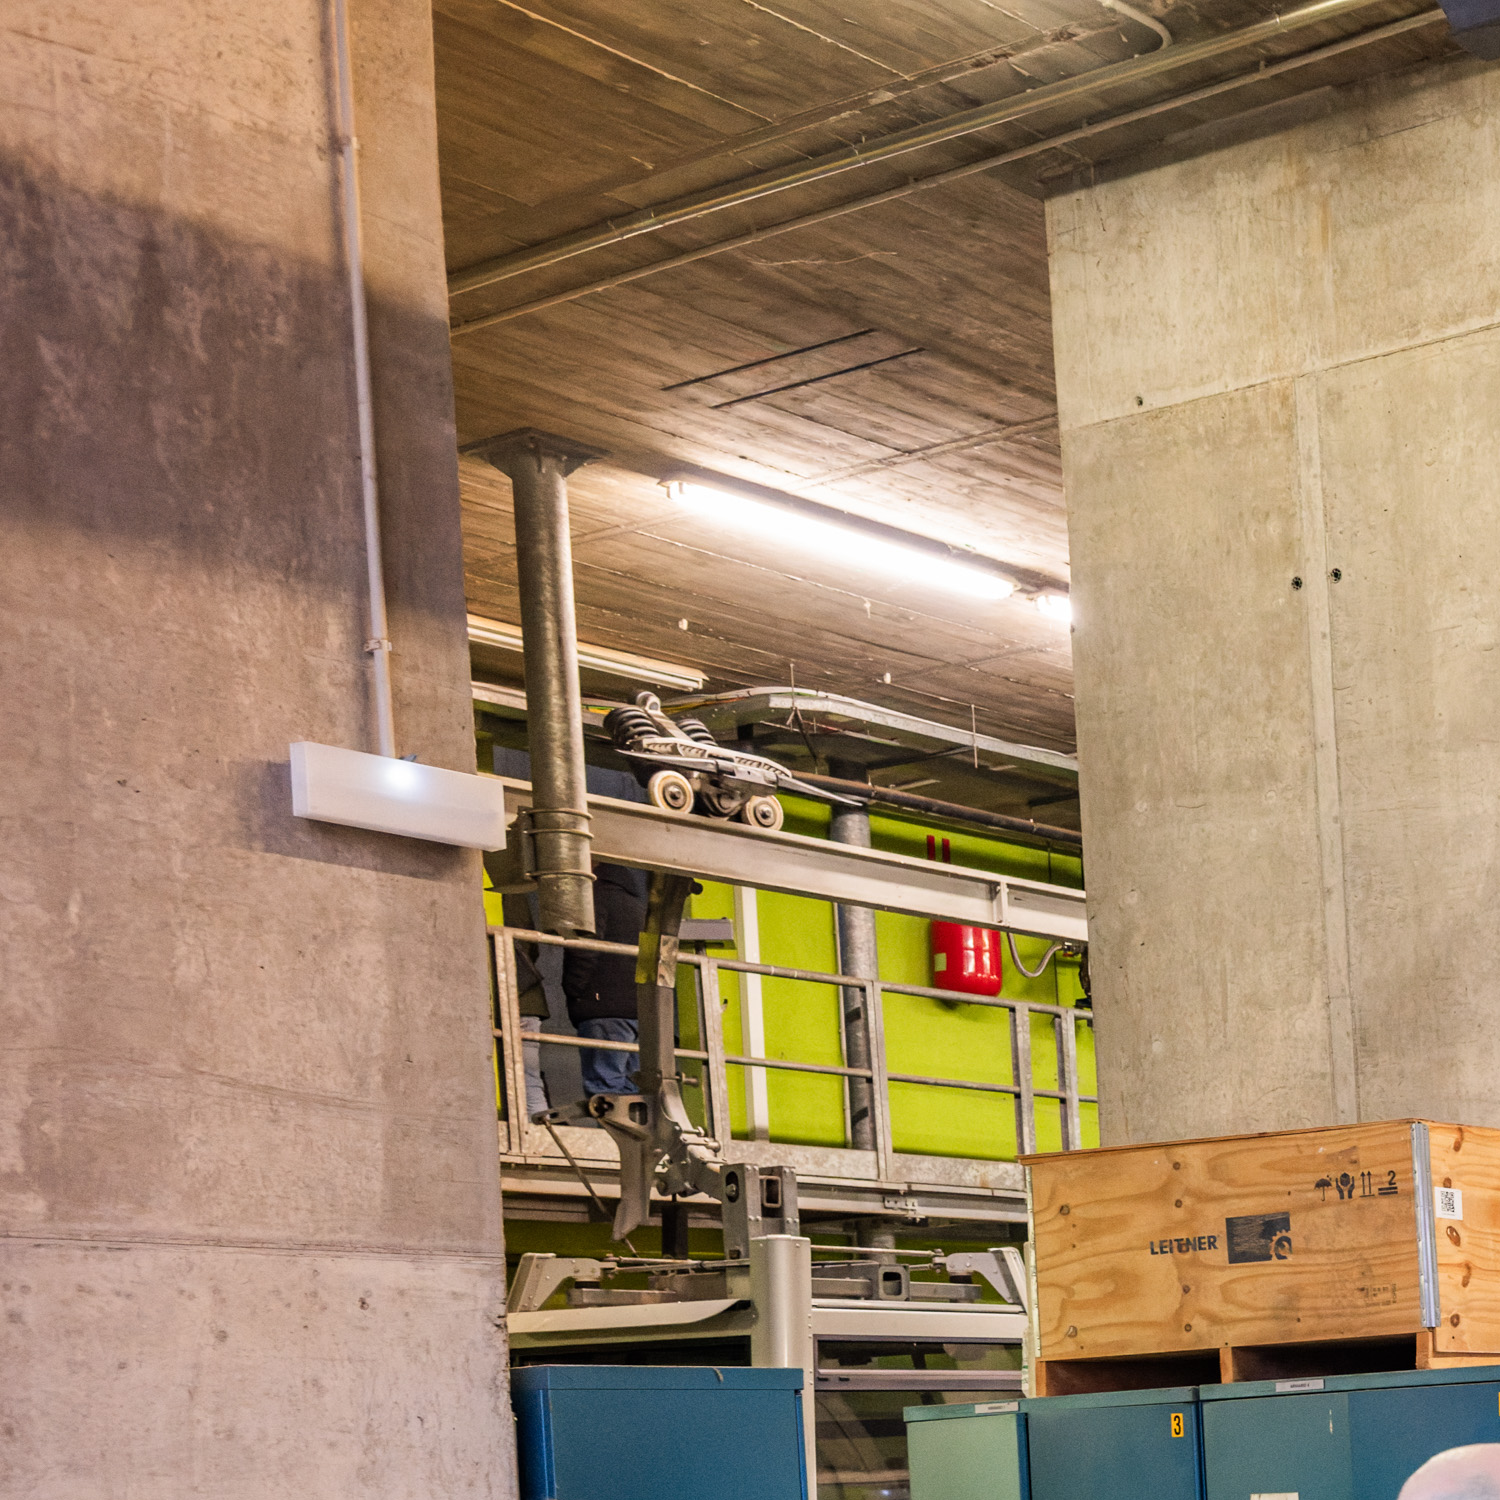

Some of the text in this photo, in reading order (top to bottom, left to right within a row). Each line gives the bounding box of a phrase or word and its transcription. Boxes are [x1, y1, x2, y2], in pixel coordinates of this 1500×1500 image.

[1387, 1170, 1396, 1186] 2
[1149, 1235, 1218, 1255] LEITNER
[1174, 1415, 1181, 1435] 3
